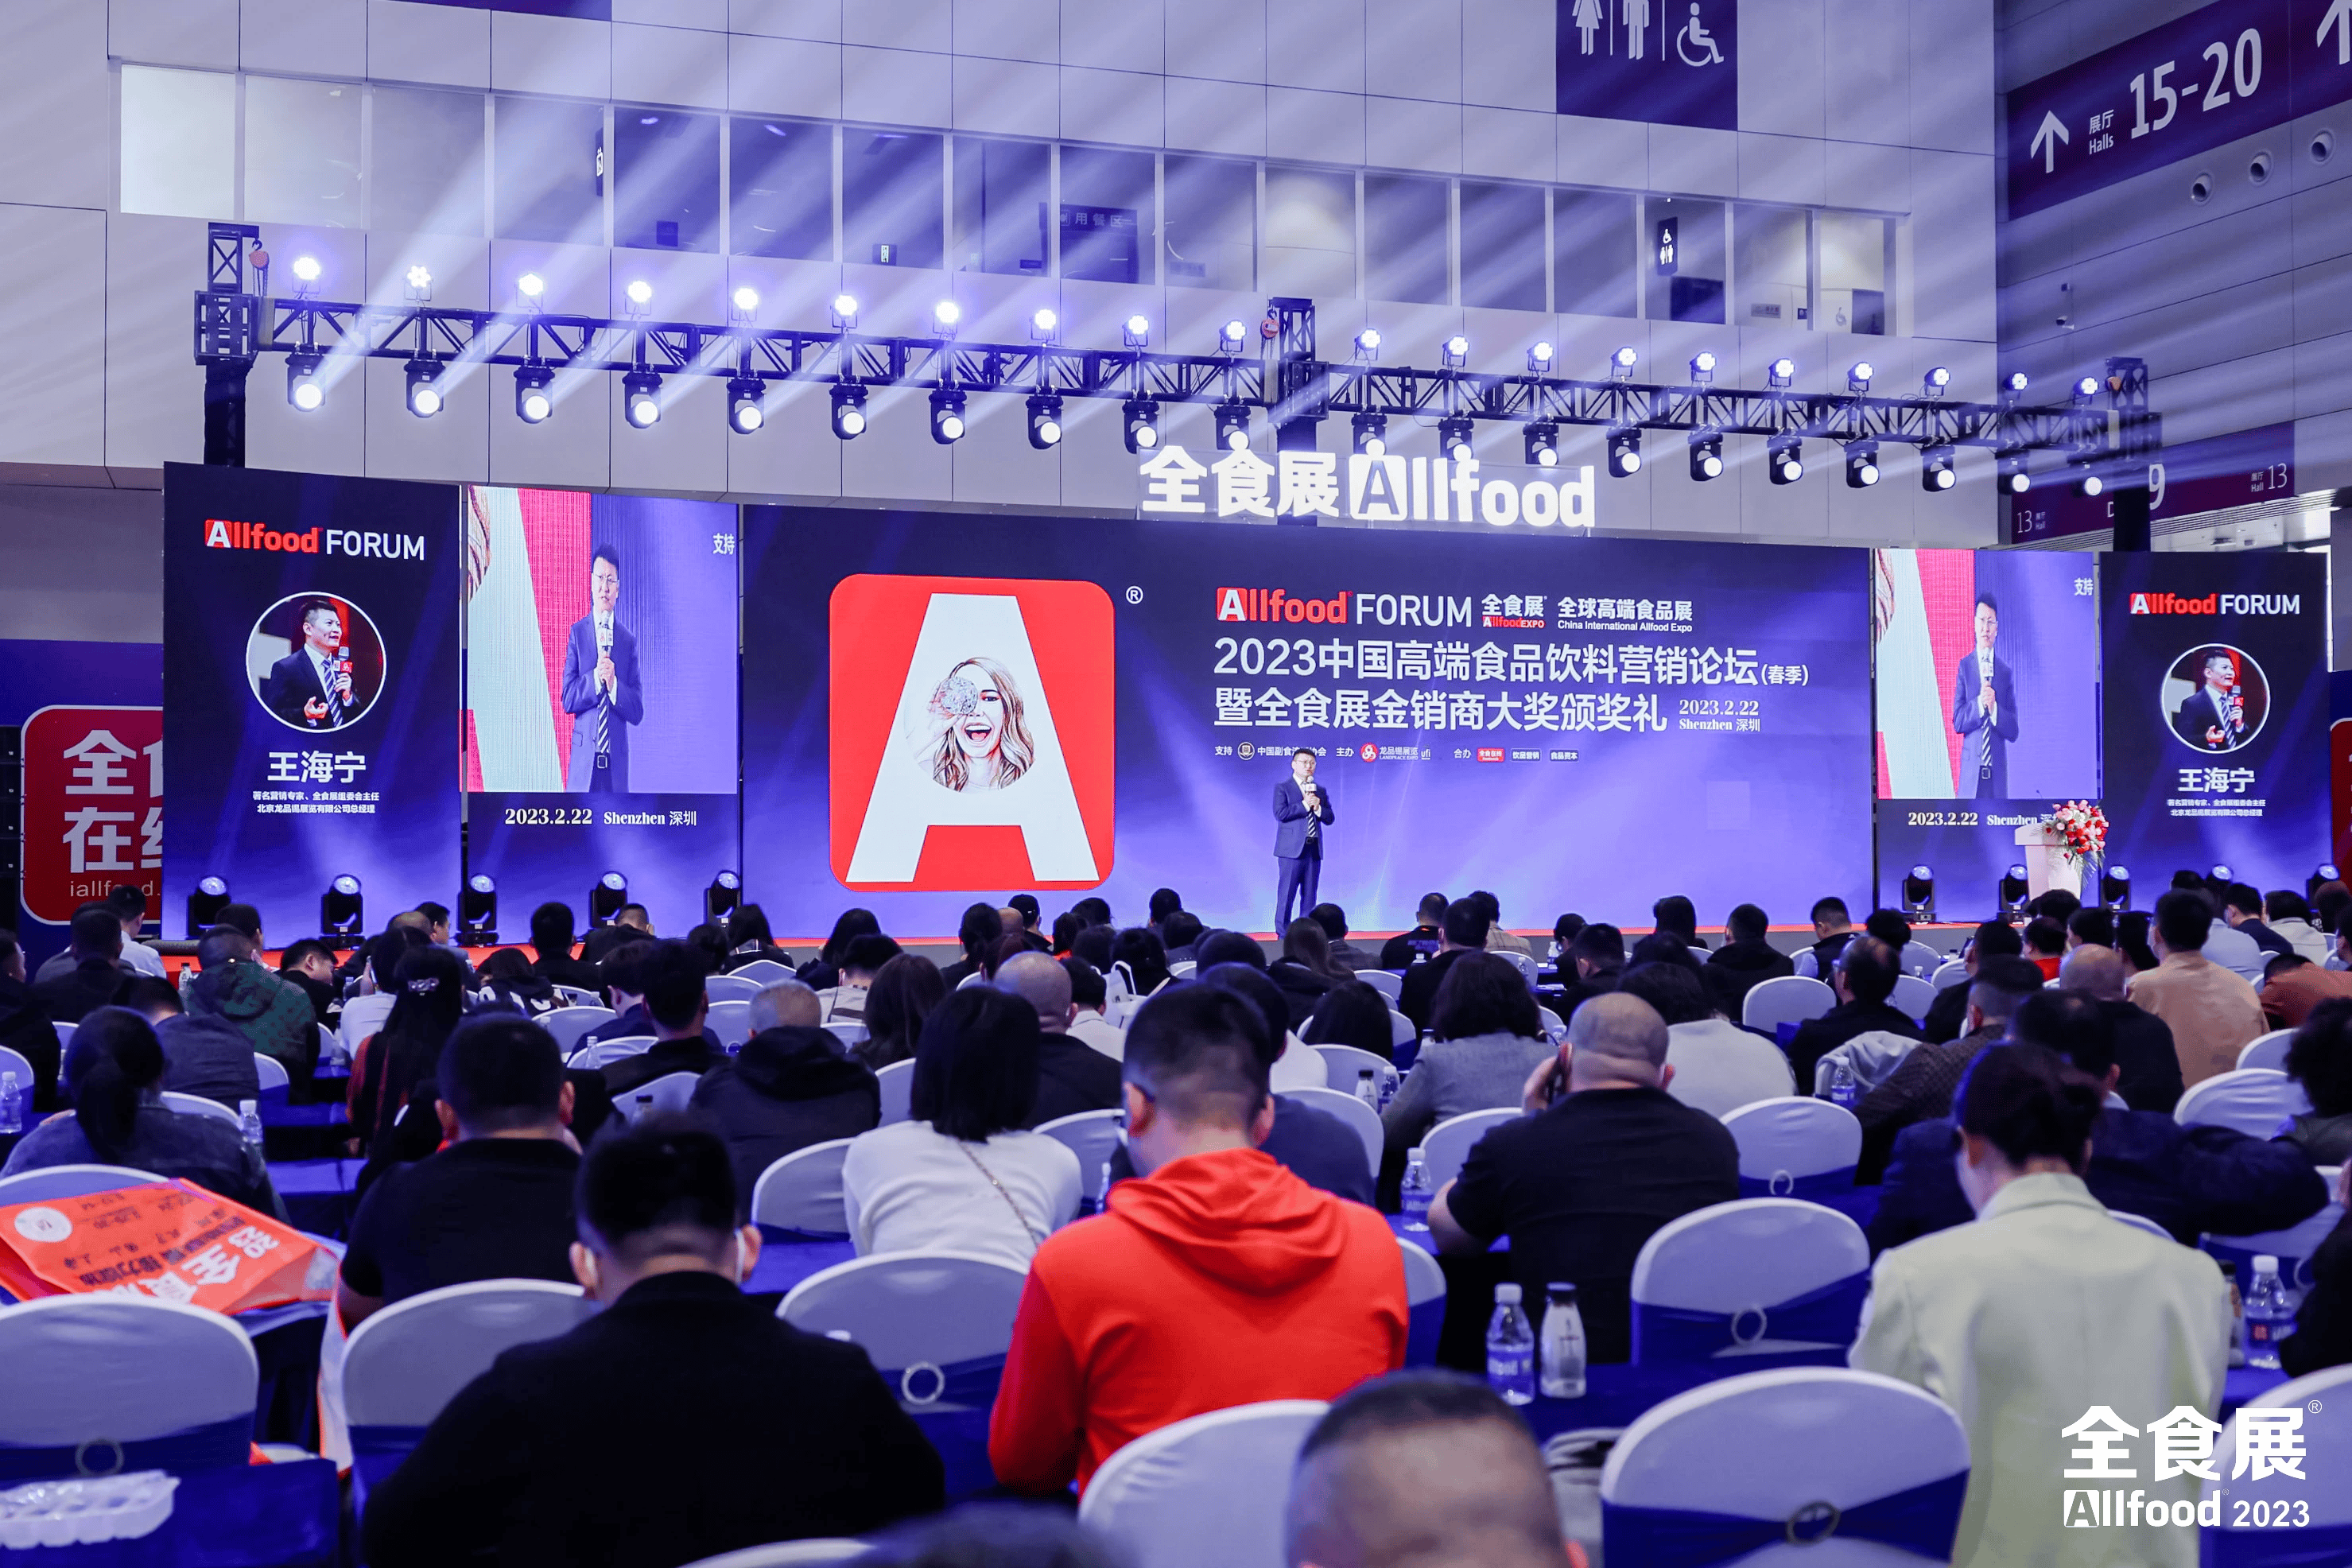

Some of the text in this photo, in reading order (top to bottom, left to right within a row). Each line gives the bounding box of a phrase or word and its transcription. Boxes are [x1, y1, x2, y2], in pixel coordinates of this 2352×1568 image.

[2130, 28, 2262, 139] 15-20
[2089, 109, 2114, 135] 展厅
[2089, 133, 2114, 155] Halls
[1139, 445, 1595, 528] 全食展 Allfood
[2251, 482, 2264, 492] Hall
[2268, 463, 2288, 490] 13
[2017, 510, 2032, 534] 13
[205, 519, 425, 560] Allfood FORUM
[712, 532, 735, 555] 支持
[2074, 577, 2094, 596] 支持
[1217, 587, 1472, 627] Allfood FORUM
[1481, 593, 1544, 617] 全食展
[1558, 596, 1693, 621] 全球高端食品展
[2130, 592, 2300, 615] Allfood FORUM
[1558, 619, 1693, 634] China International Allfood Expo
[1213, 687, 1667, 732] 暨全食展金销商大奖颁奖礼
[1679, 699, 1759, 716] 2023.2.22
[1679, 718, 1760, 732] Shenzhen 深圳
[64, 729, 163, 798] 全
[1215, 746, 1232, 755] 支持
[1336, 747, 1354, 757] 主办
[1454, 749, 1471, 759] 合办
[267, 750, 367, 782] 王海宁
[2178, 767, 2256, 793] 王海宁
[505, 808, 697, 826] 2023.2.22 Shenzhen 深圳
[1908, 812, 1978, 825] 2023.2.22
[1987, 814, 2038, 826] Shenzhen
[70, 880, 161, 897] iallfd.
